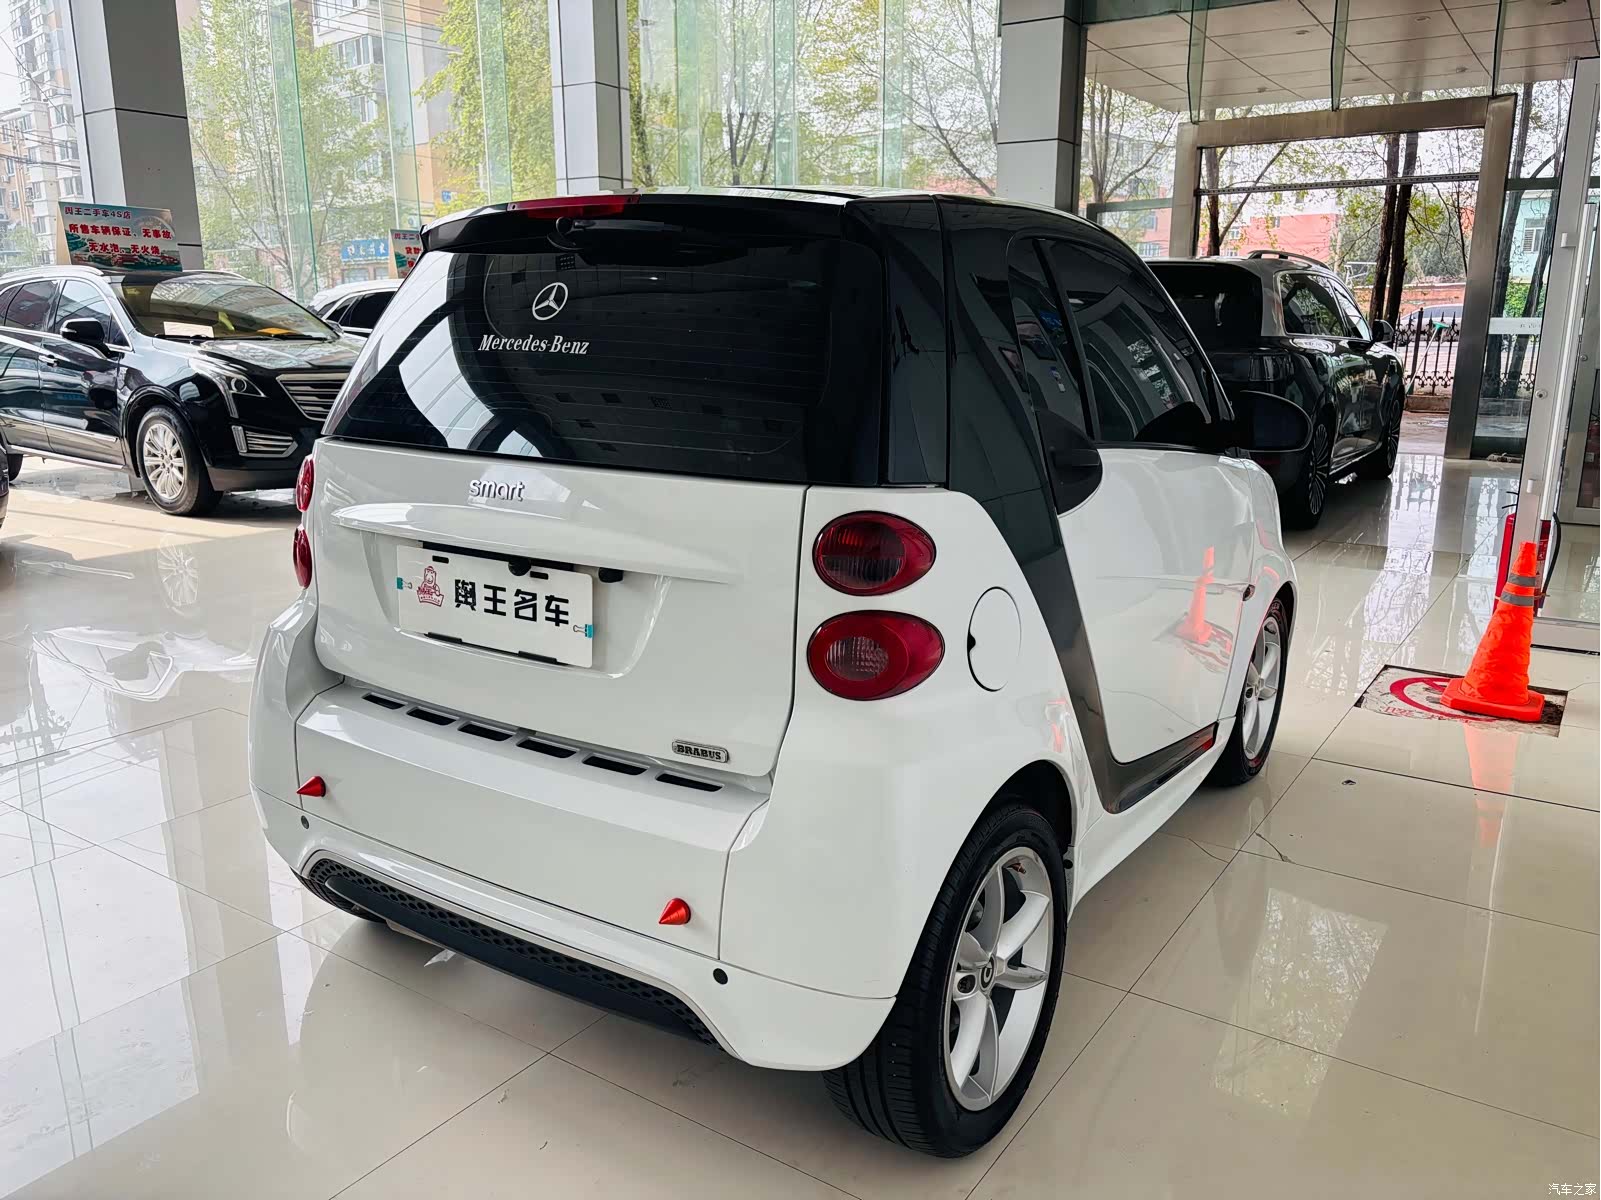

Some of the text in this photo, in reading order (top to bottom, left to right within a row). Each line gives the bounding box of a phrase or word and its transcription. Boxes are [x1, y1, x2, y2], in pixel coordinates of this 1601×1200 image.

[478, 334, 590, 355] Mercedes-Benz
[469, 480, 526, 502] smart
[676, 744, 721, 760] BRABUS
